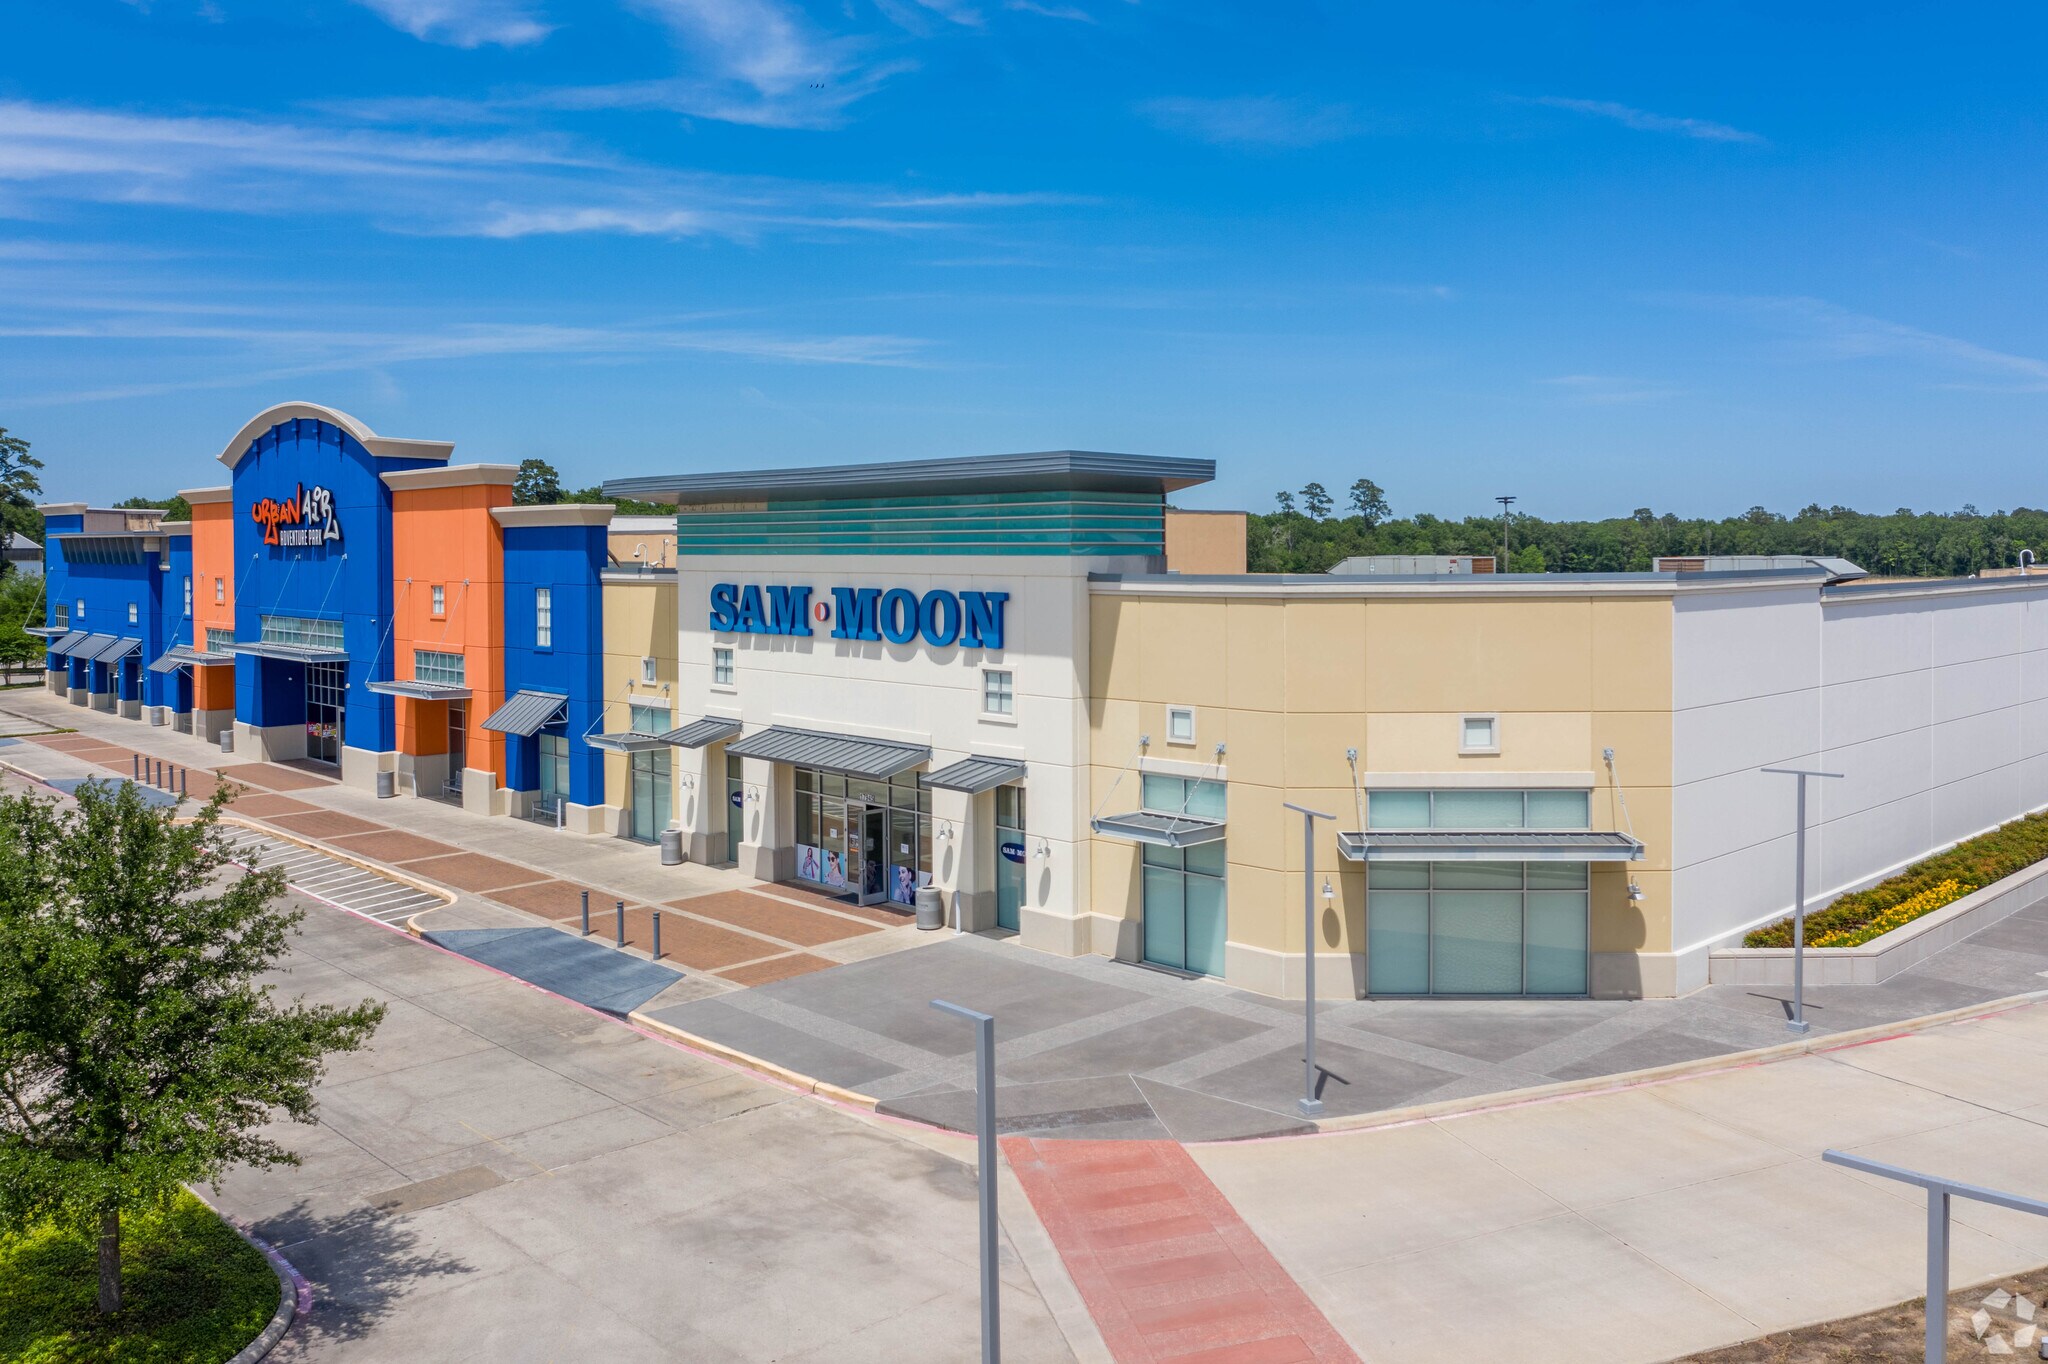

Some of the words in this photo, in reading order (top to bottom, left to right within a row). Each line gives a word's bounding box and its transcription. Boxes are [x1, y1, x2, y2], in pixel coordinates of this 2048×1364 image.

[252, 483, 301, 545] URBAN
[280, 530, 308, 546] ADVENTURE
[309, 529, 323, 546] PARK
[710, 583, 813, 637] SAM
[831, 587, 1009, 649] MOON
